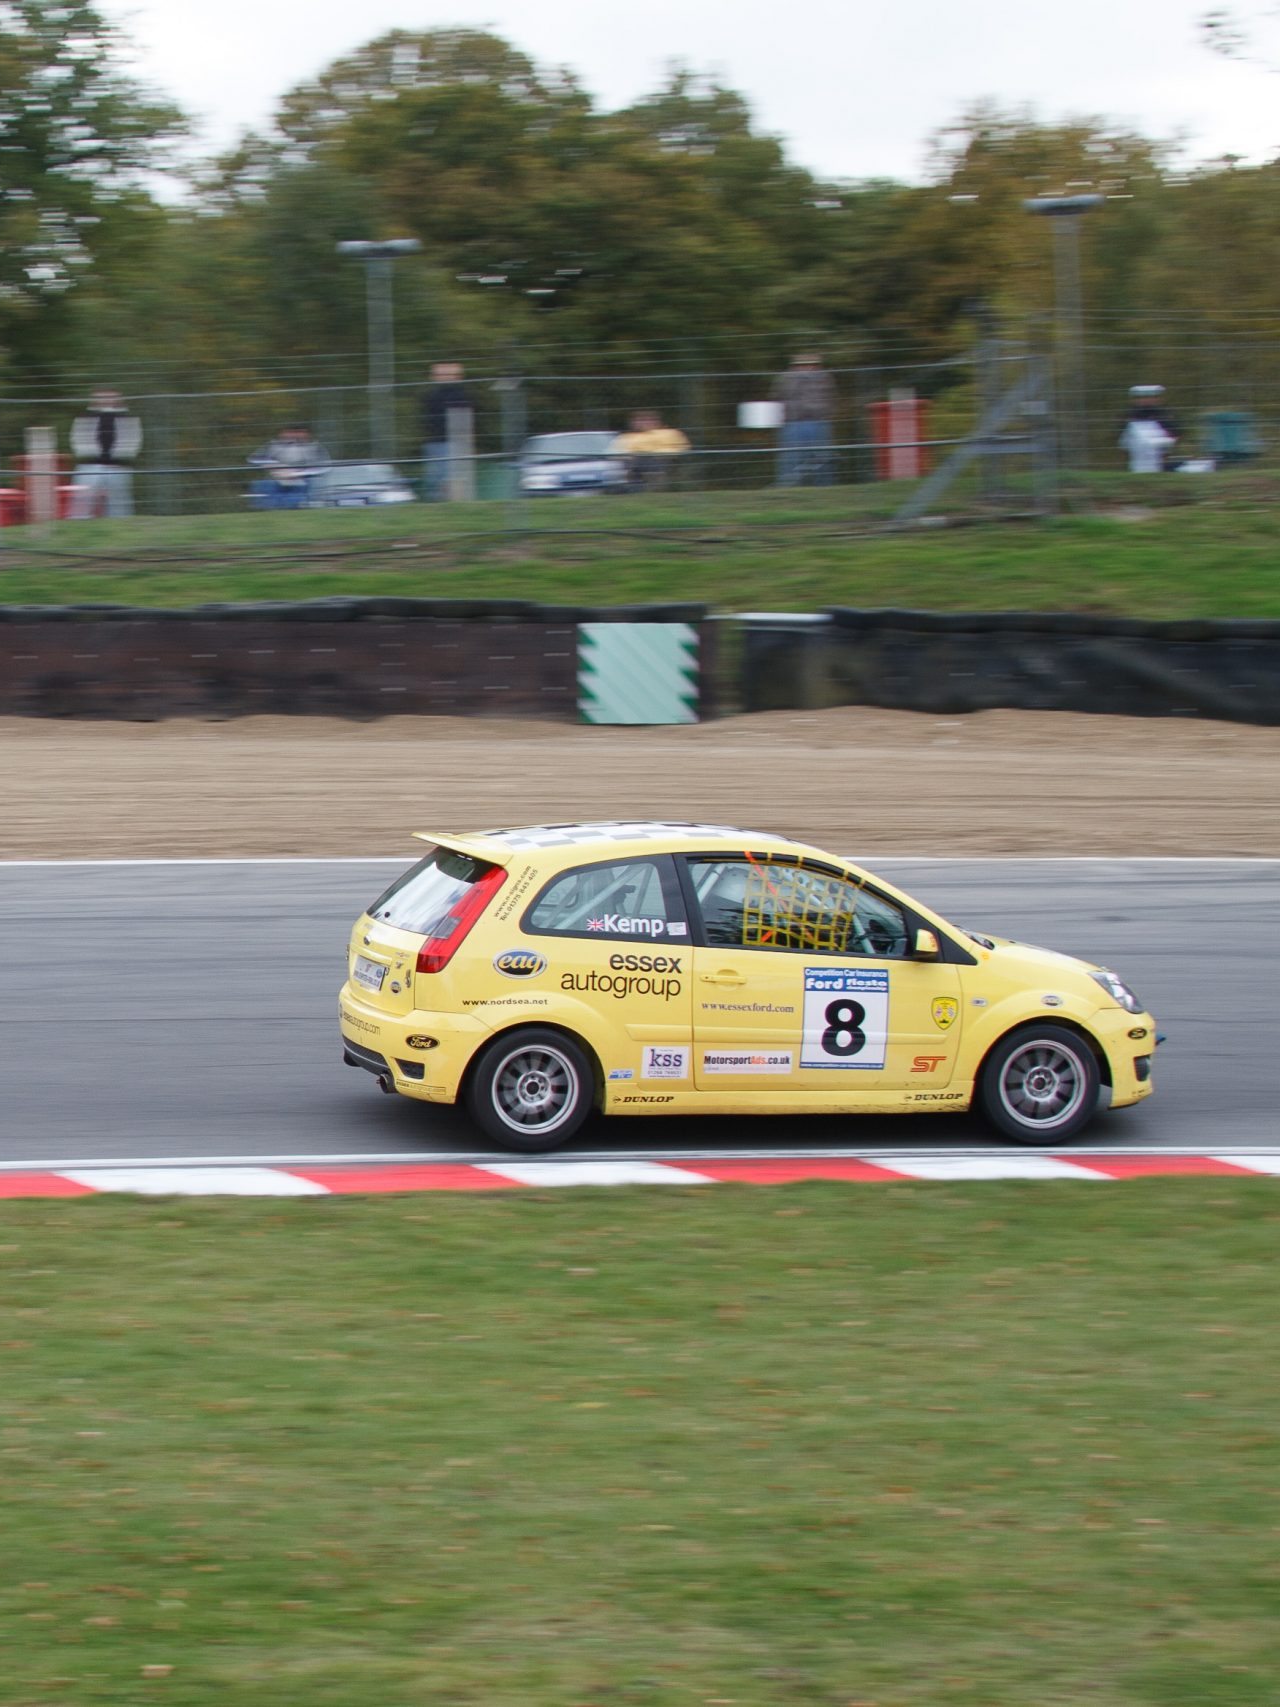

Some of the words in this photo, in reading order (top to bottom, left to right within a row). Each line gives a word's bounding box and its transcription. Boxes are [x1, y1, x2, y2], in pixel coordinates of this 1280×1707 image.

[604, 914, 664, 938] Kemp
[609, 953, 682, 973] essex
[560, 970, 681, 1001] autogroup
[805, 978, 843, 990] Ford
[462, 998, 548, 1006] www.nordsea.net
[701, 1003, 794, 1013] www.essexford.com
[821, 998, 866, 1056] 8
[410, 1036, 432, 1048] Ford
[649, 1048, 683, 1067] kss
[704, 1055, 790, 1067] MotorsportAds.co.uk
[910, 1056, 947, 1072] ST
[914, 1093, 964, 1101] DUNLOP
